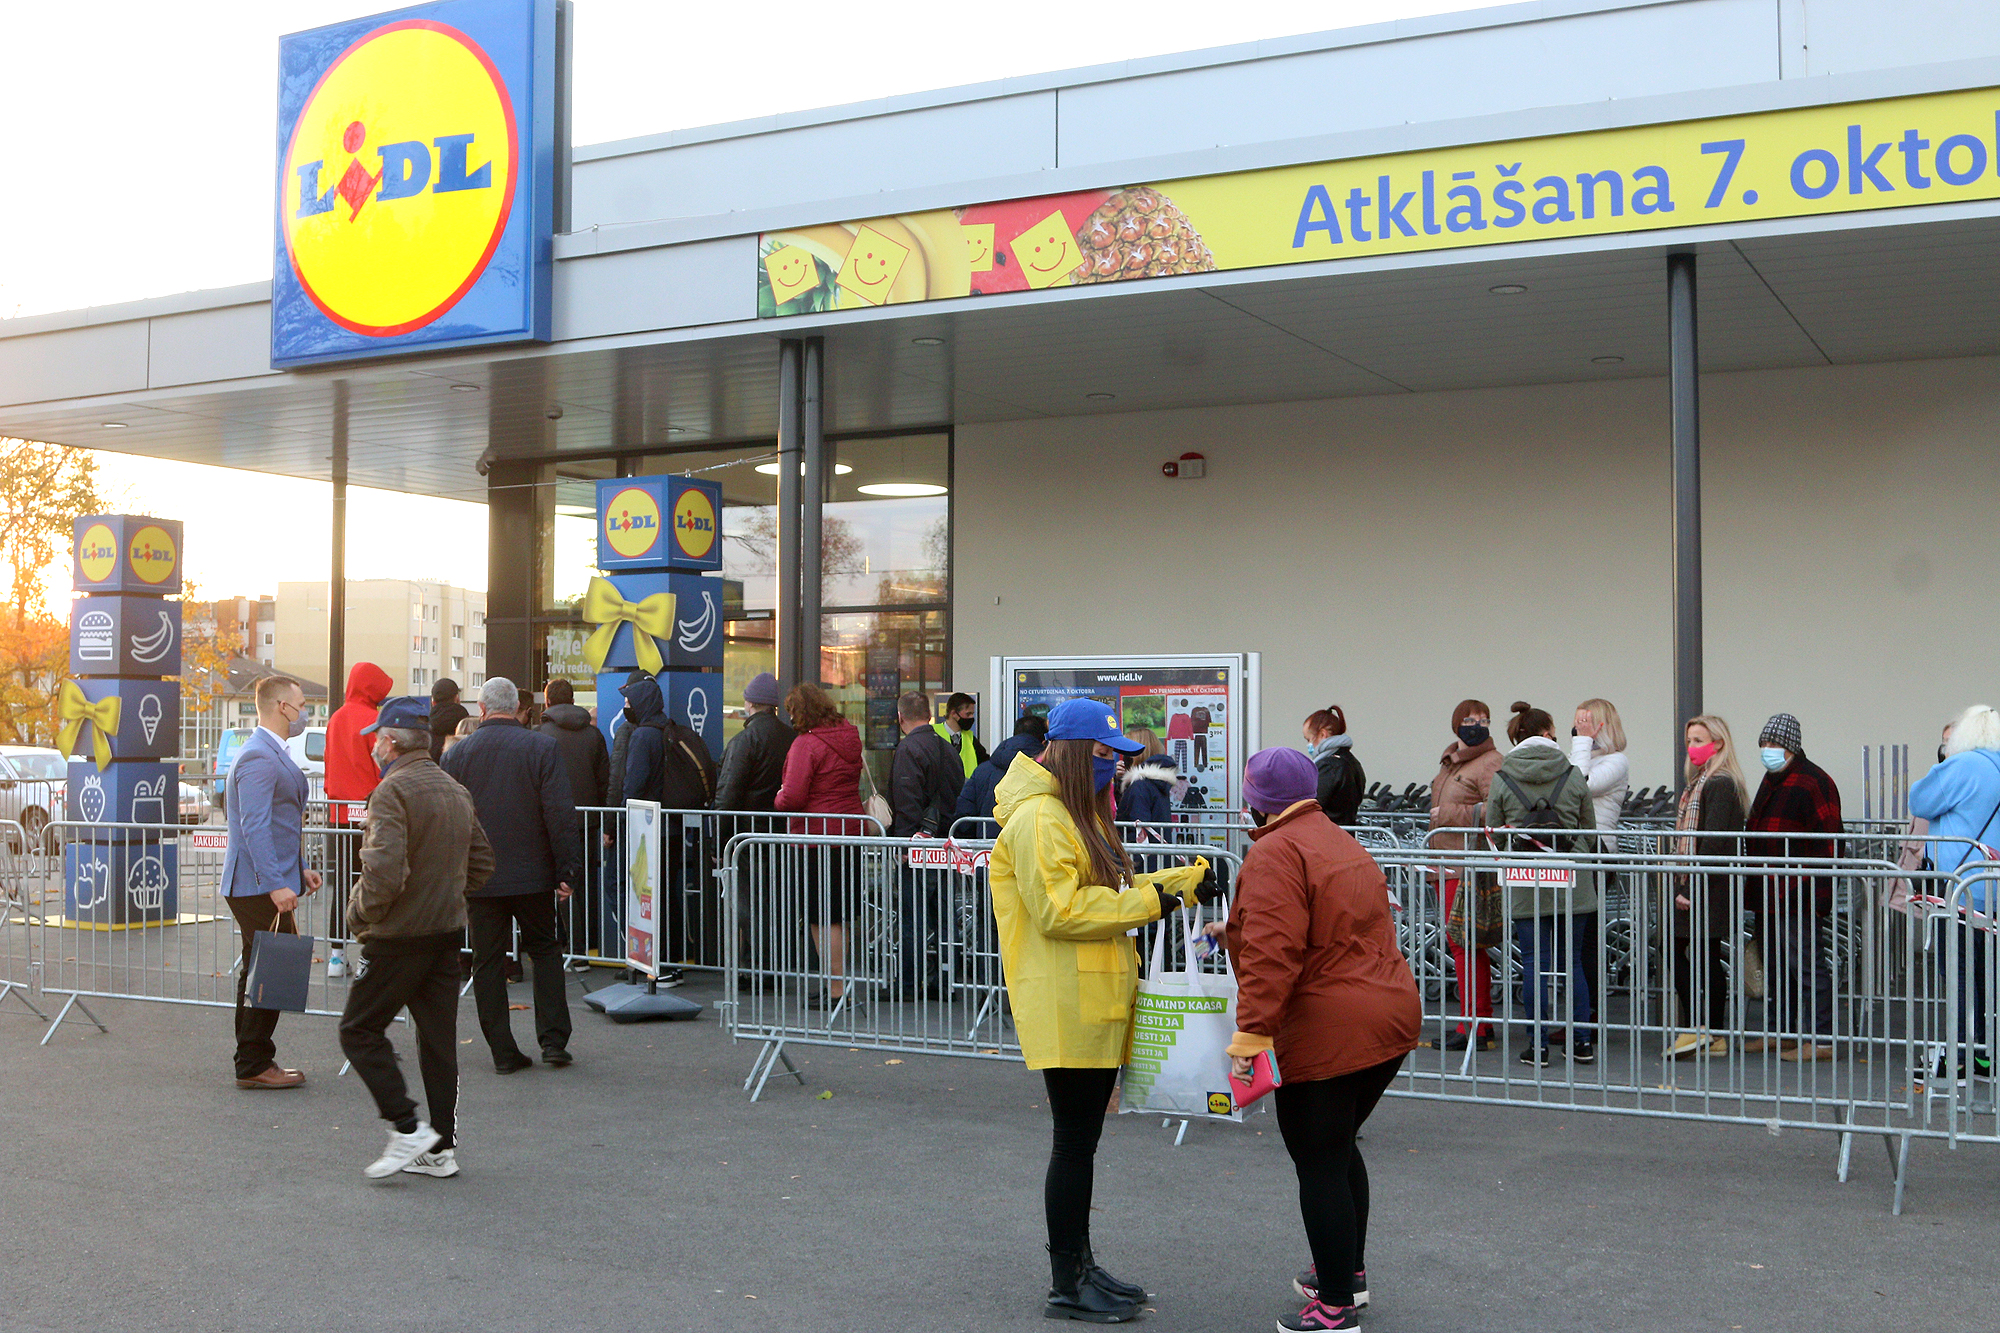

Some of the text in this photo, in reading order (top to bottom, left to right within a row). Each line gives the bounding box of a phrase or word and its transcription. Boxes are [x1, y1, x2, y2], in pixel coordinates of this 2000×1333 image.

[1291, 162, 1675, 249] Atklāšana
[1700, 138, 1759, 209] 7.
[1096, 672, 1143, 682] www.lidl.lv
[194, 836, 227, 847] JAKUBIN
[1155, 999, 1186, 1010] MIND
[1188, 1000, 1223, 1011] KAASA
[1165, 1018, 1179, 1027] JA
[1160, 1034, 1171, 1043] JA
